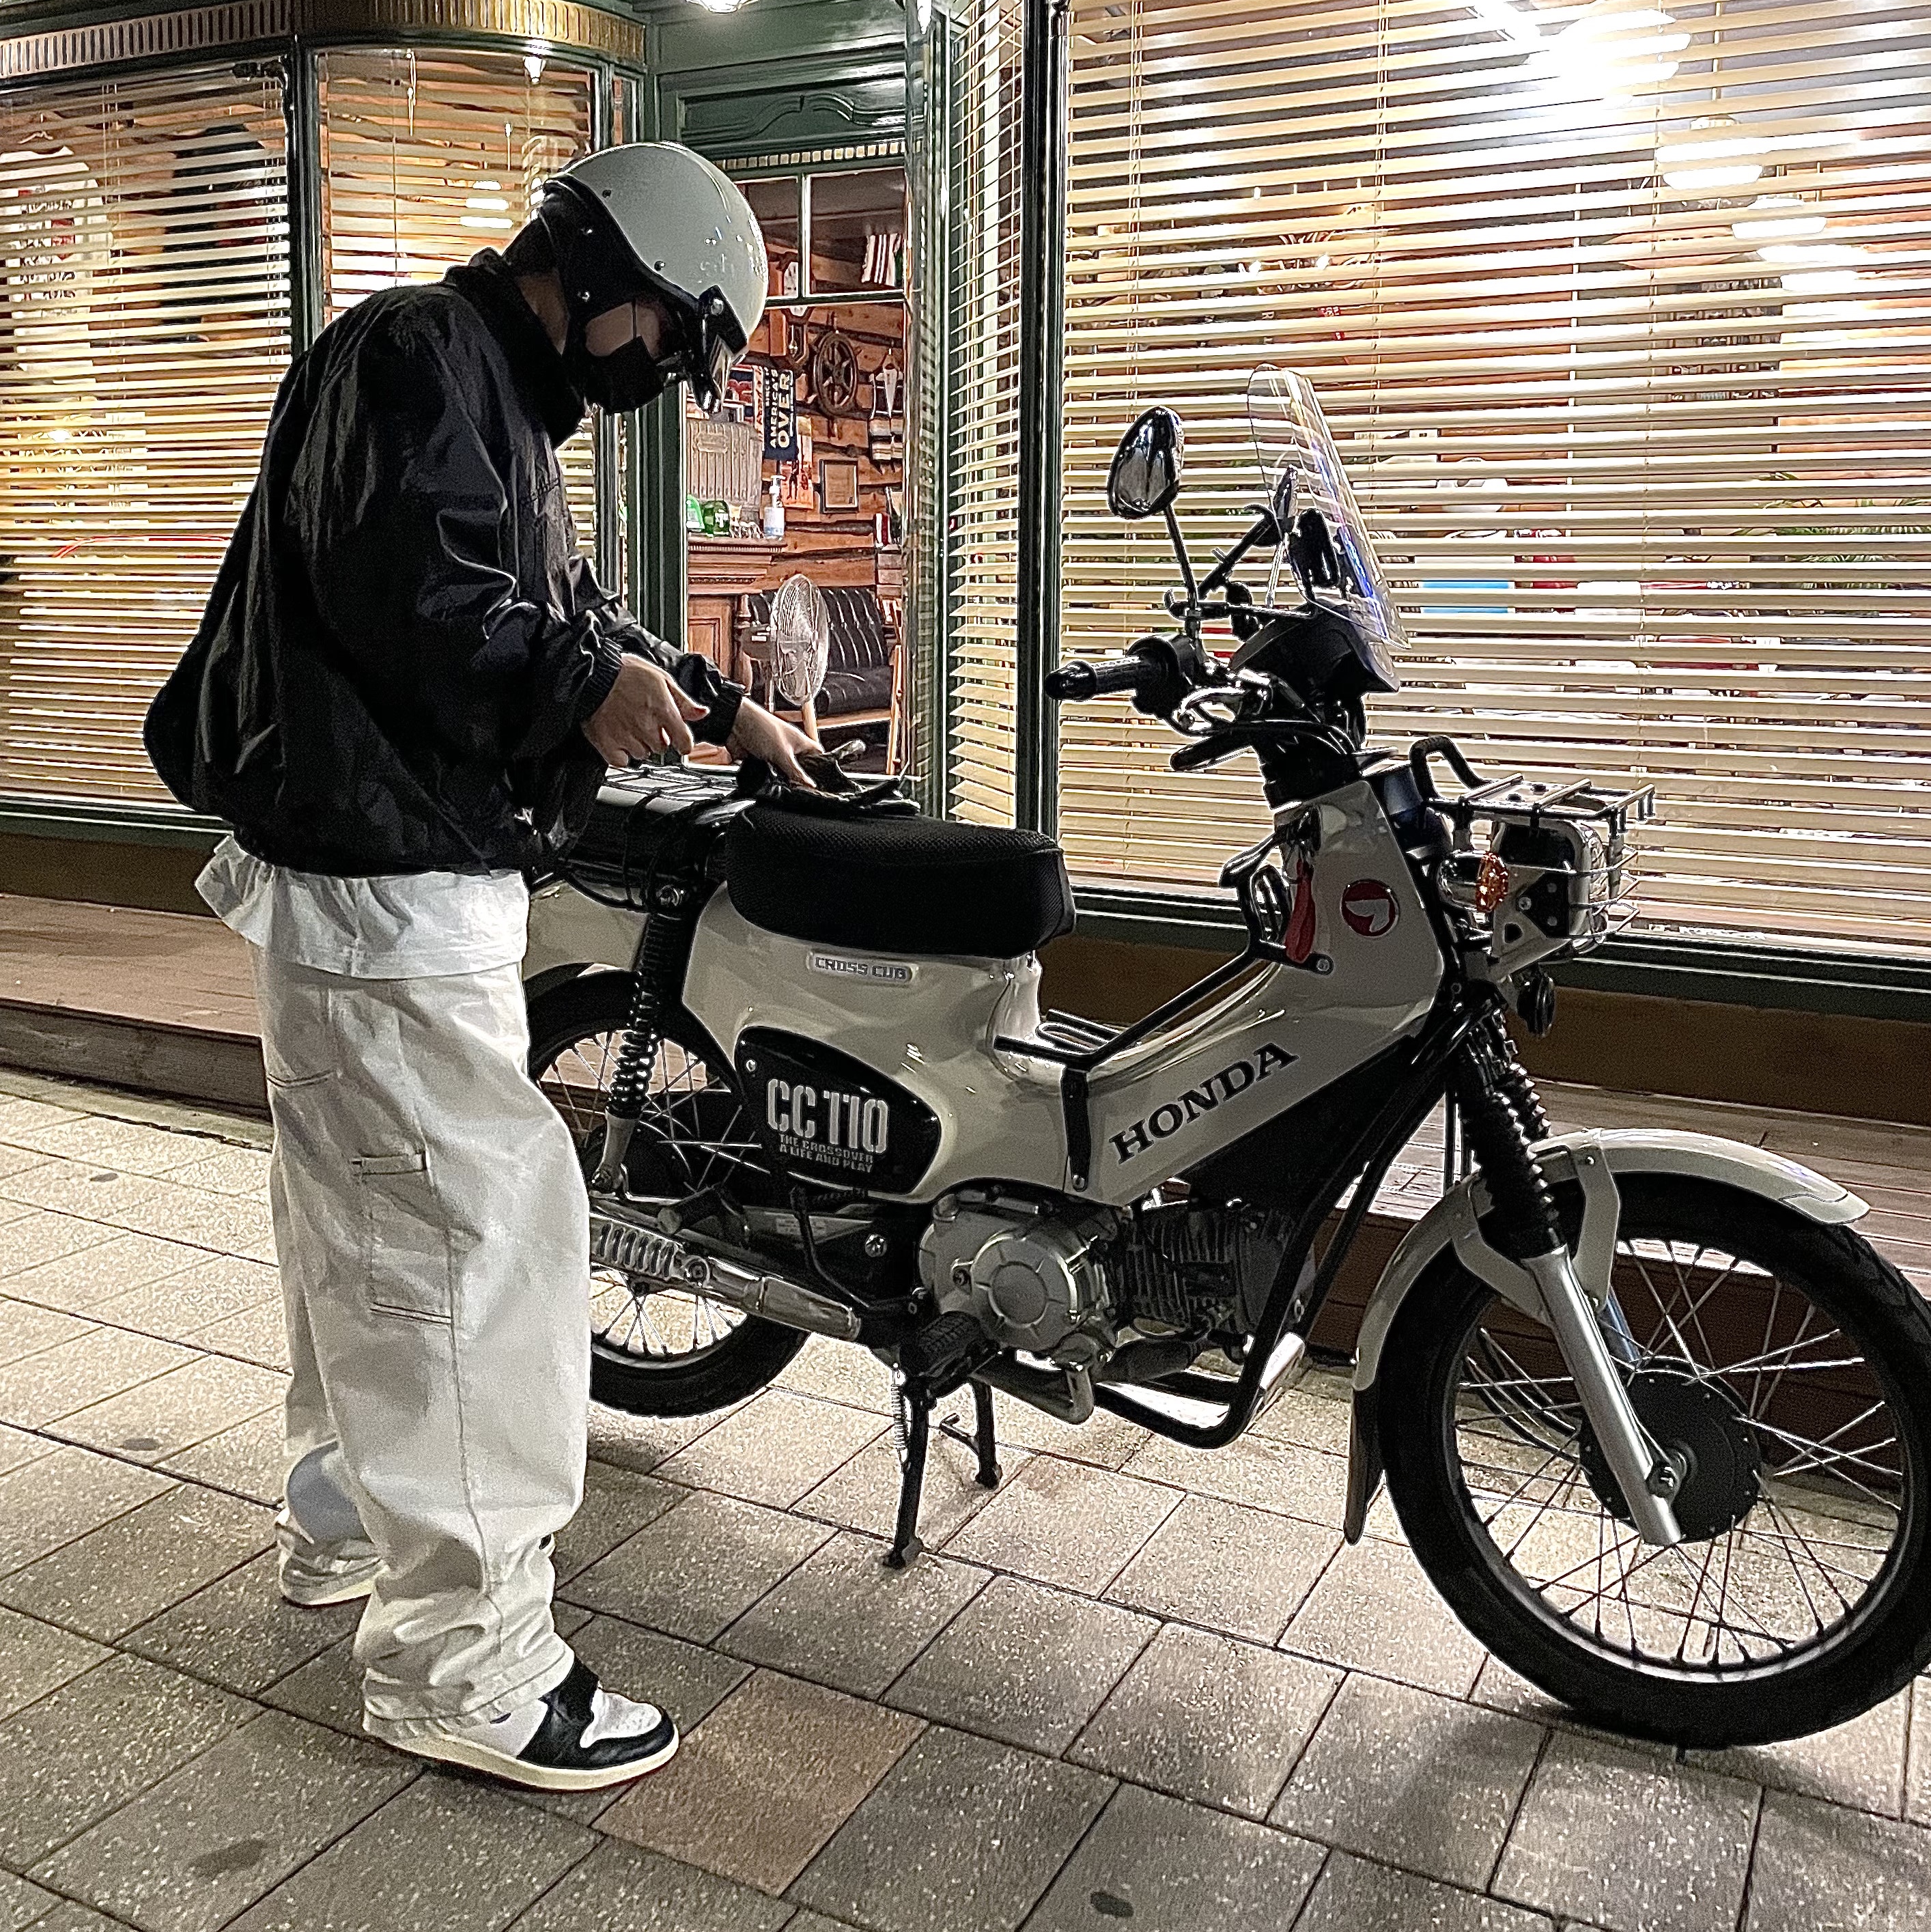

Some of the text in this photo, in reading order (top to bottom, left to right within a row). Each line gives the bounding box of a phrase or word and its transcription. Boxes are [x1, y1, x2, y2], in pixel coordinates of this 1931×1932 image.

[778, 373, 790, 448] OVER
[815, 957, 907, 980] CROSS CUB
[1108, 1042, 1299, 1165] HONDA
[779, 1143, 873, 1173] A LIFE AND PLAY
[780, 1133, 874, 1164] THE CROSSOVER
